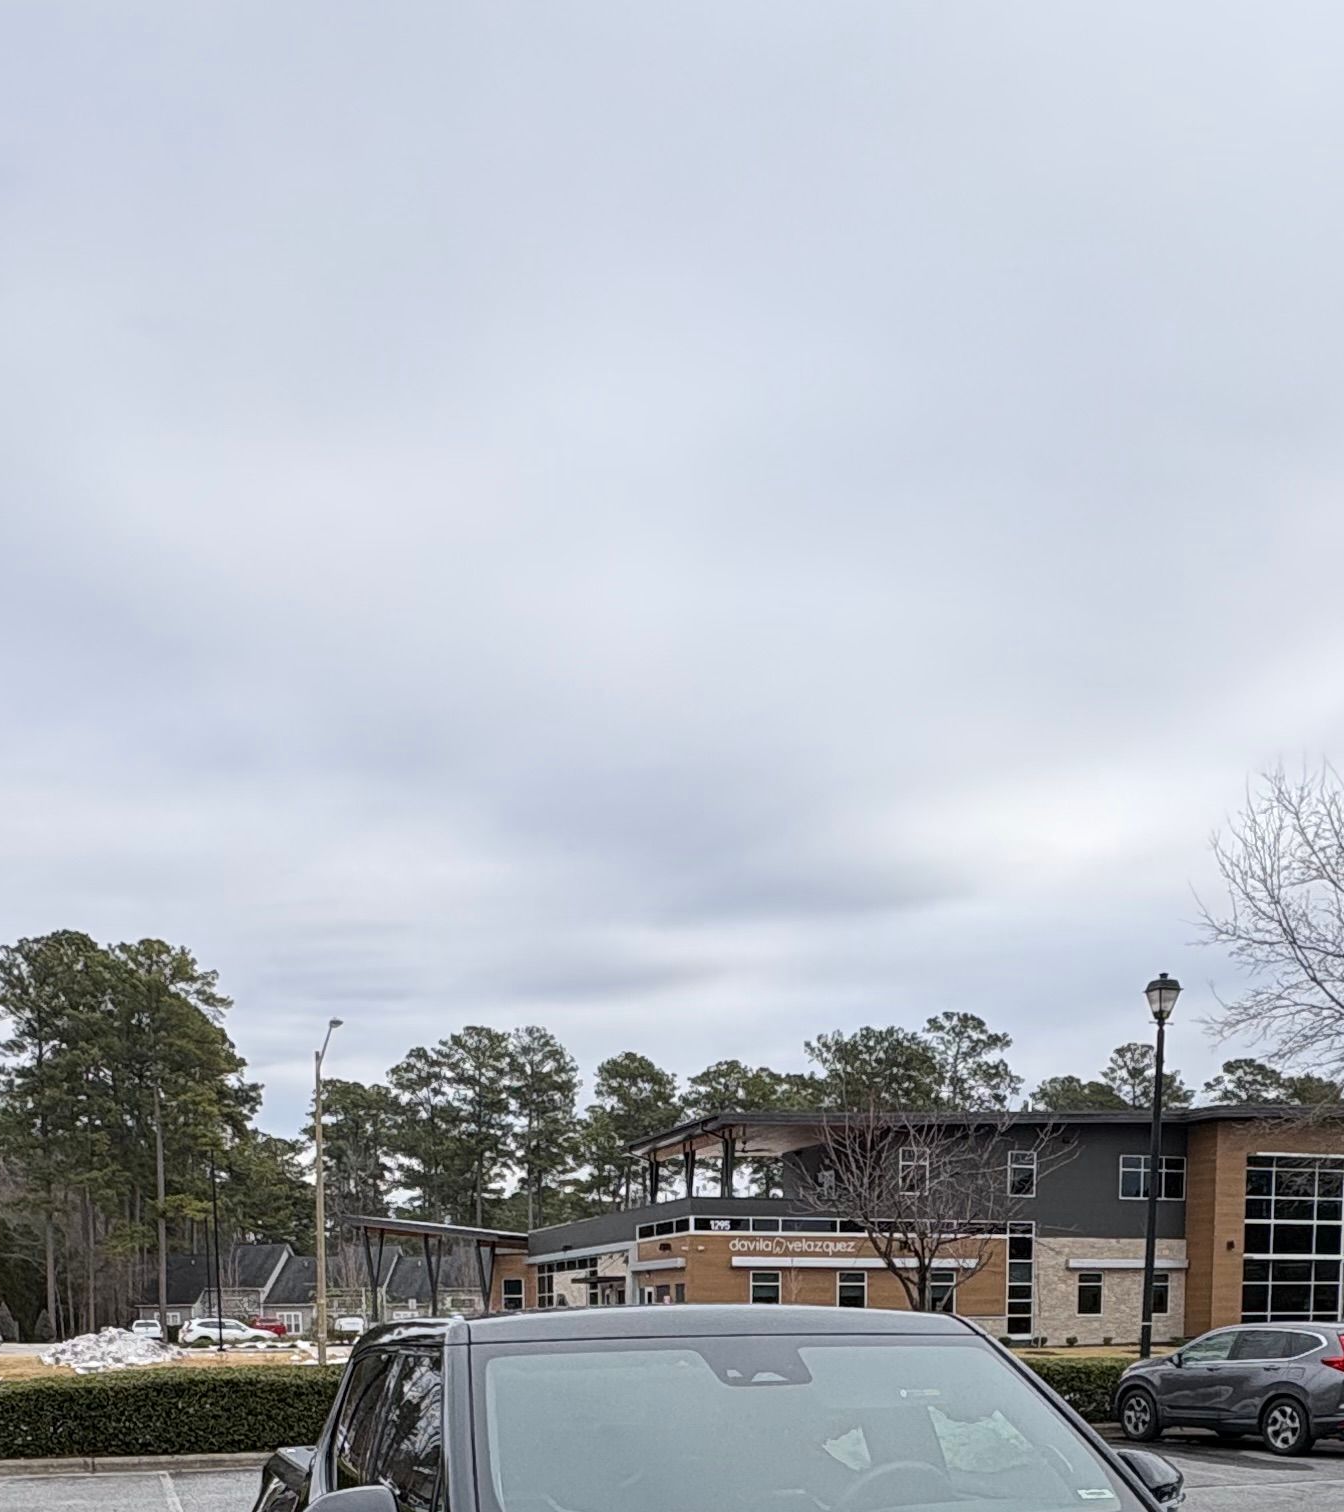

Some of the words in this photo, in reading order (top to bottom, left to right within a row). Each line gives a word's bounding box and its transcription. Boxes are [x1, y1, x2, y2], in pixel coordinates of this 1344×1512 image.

[710, 1219, 731, 1231] 1295
[729, 1238, 772, 1252] davila
[786, 1238, 857, 1256] velazquez
